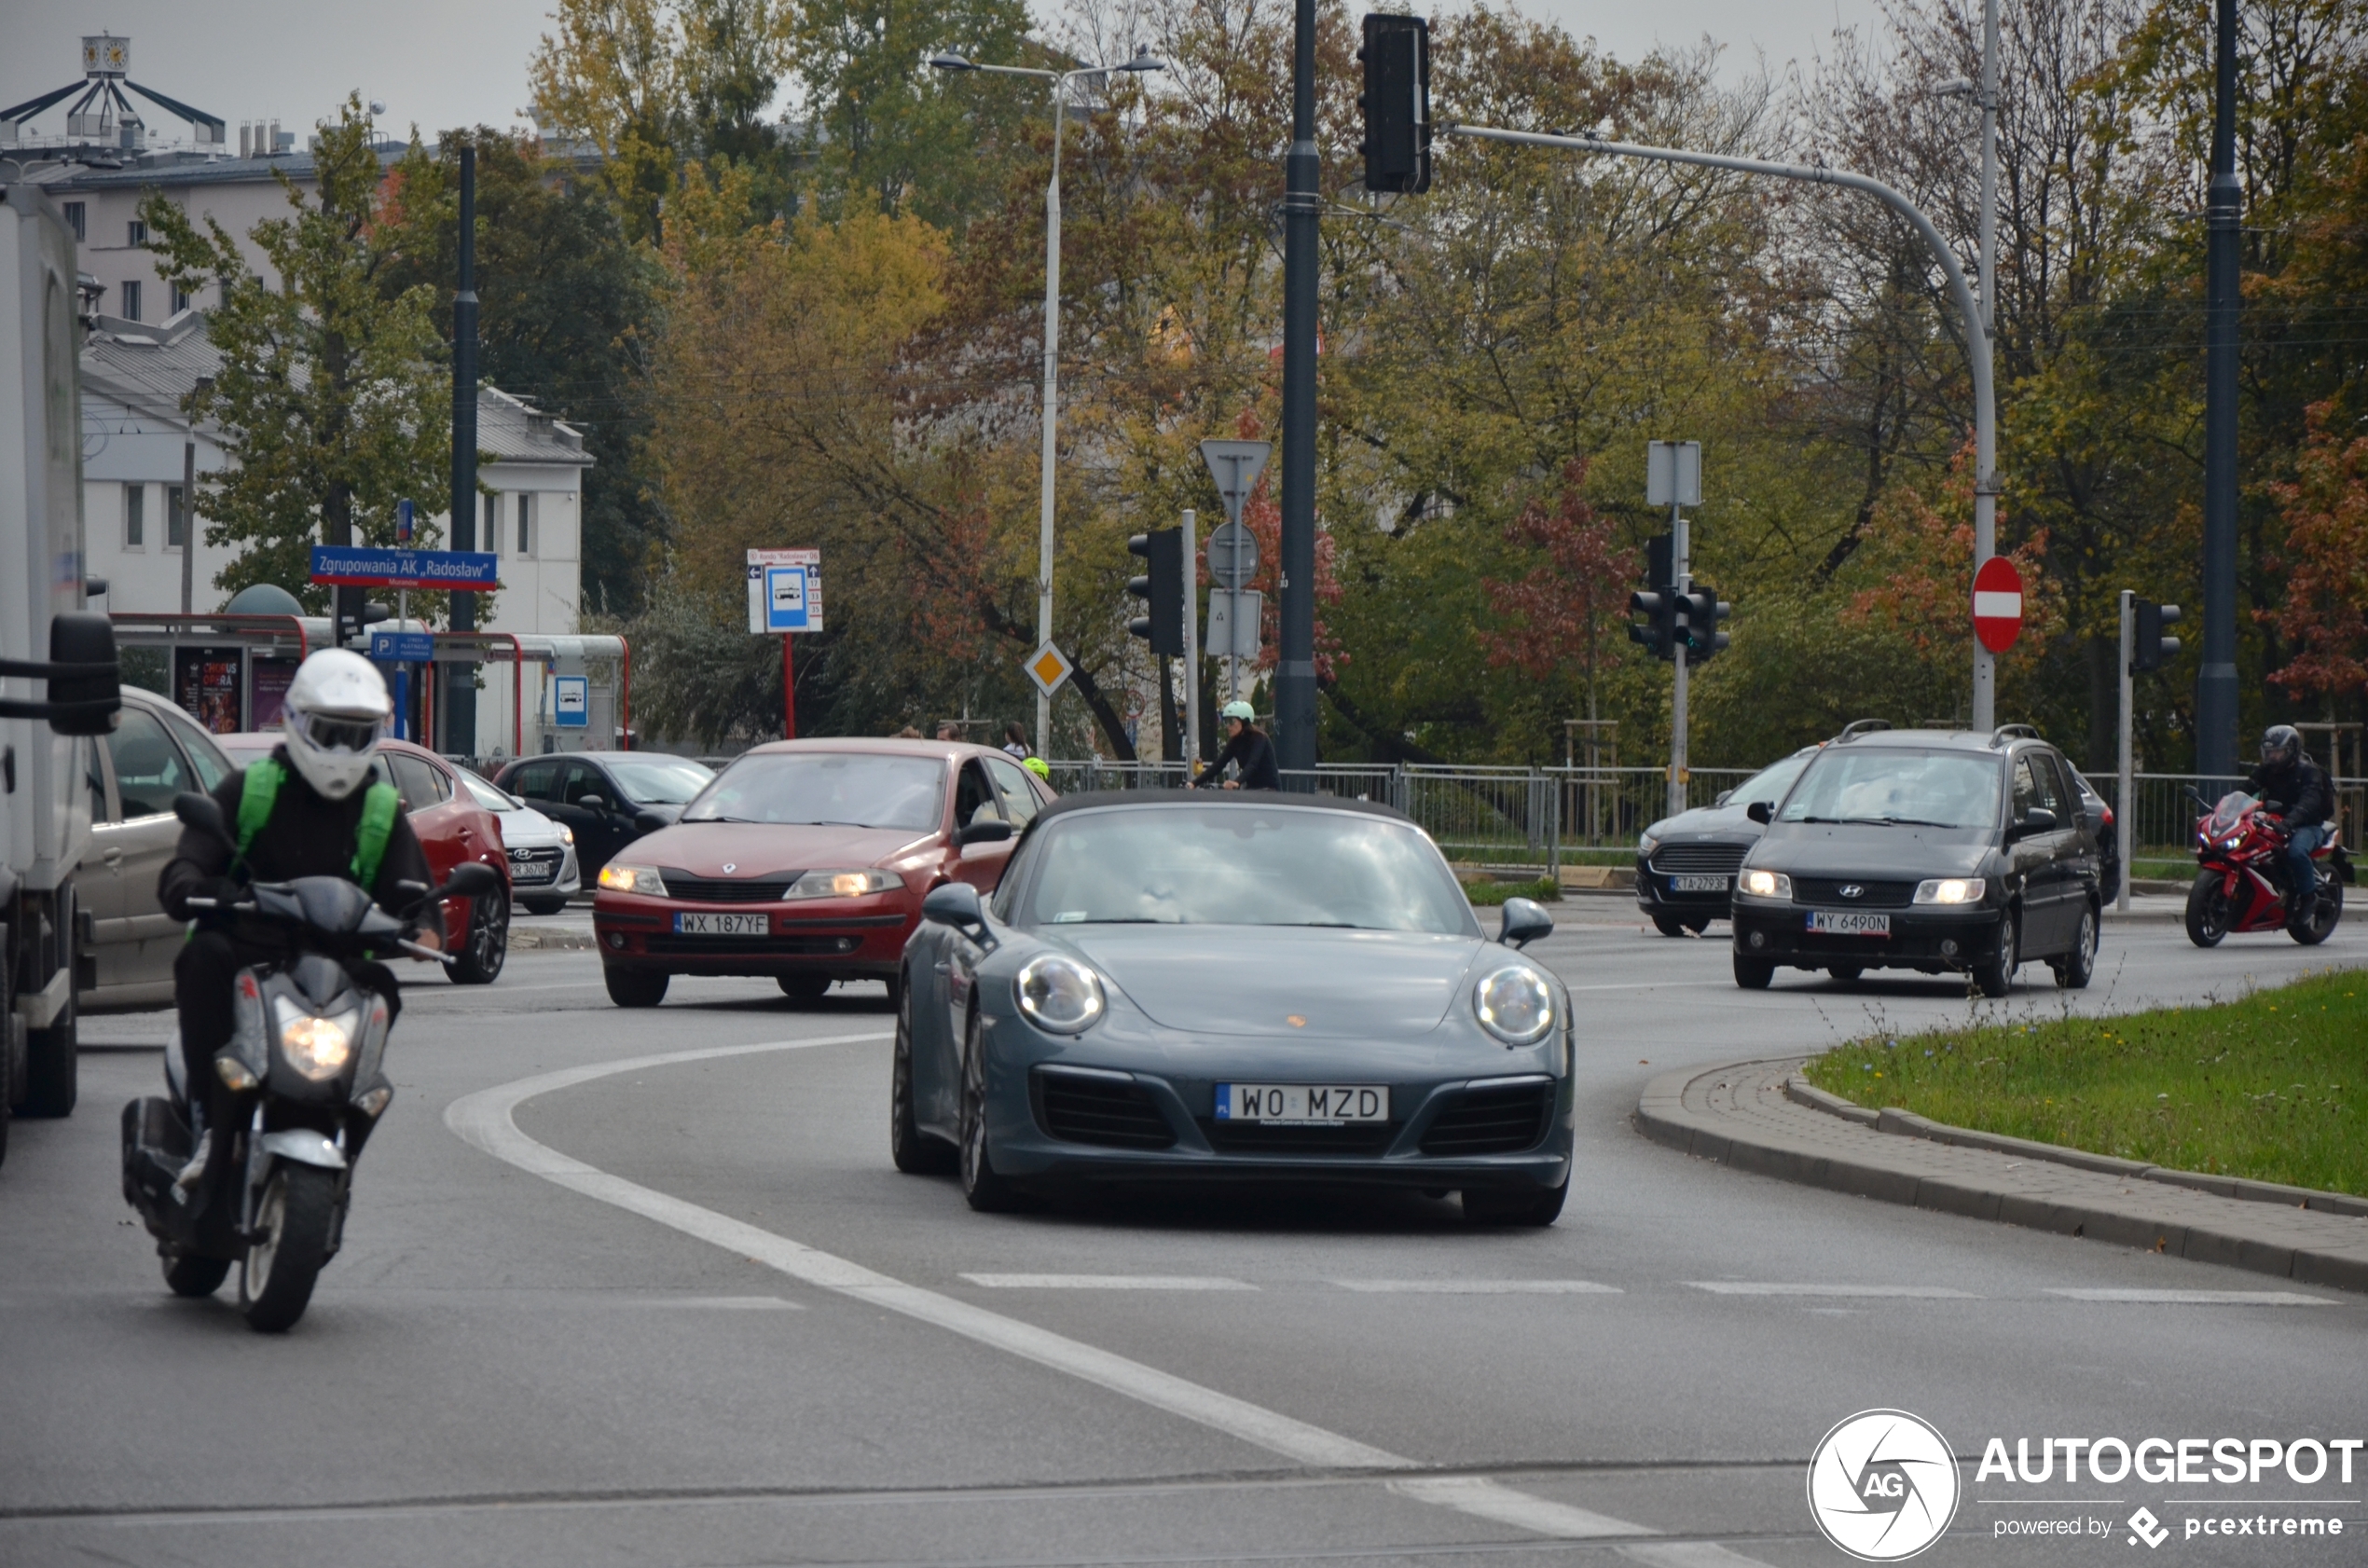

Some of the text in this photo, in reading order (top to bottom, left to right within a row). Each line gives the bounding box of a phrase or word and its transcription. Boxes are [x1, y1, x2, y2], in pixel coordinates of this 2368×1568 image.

[394, 550, 415, 558] Rondo
[809, 552, 819, 560] 06
[319, 556, 397, 576] Zgrupowania
[400, 559, 418, 575] AK
[388, 578, 419, 586] Muranów
[810, 592, 819, 600] 33
[811, 605, 819, 613] 35
[379, 639, 390, 653] P
[524, 864, 548, 874] 3670H
[1676, 877, 1727, 889] KTA 2793F
[684, 915, 707, 932] WX
[714, 915, 766, 932] 187YF
[1817, 914, 1835, 928] WY
[1840, 915, 1886, 930] 6490N
[1218, 1105, 1229, 1114] PL
[1308, 1089, 1380, 1118] MZD
